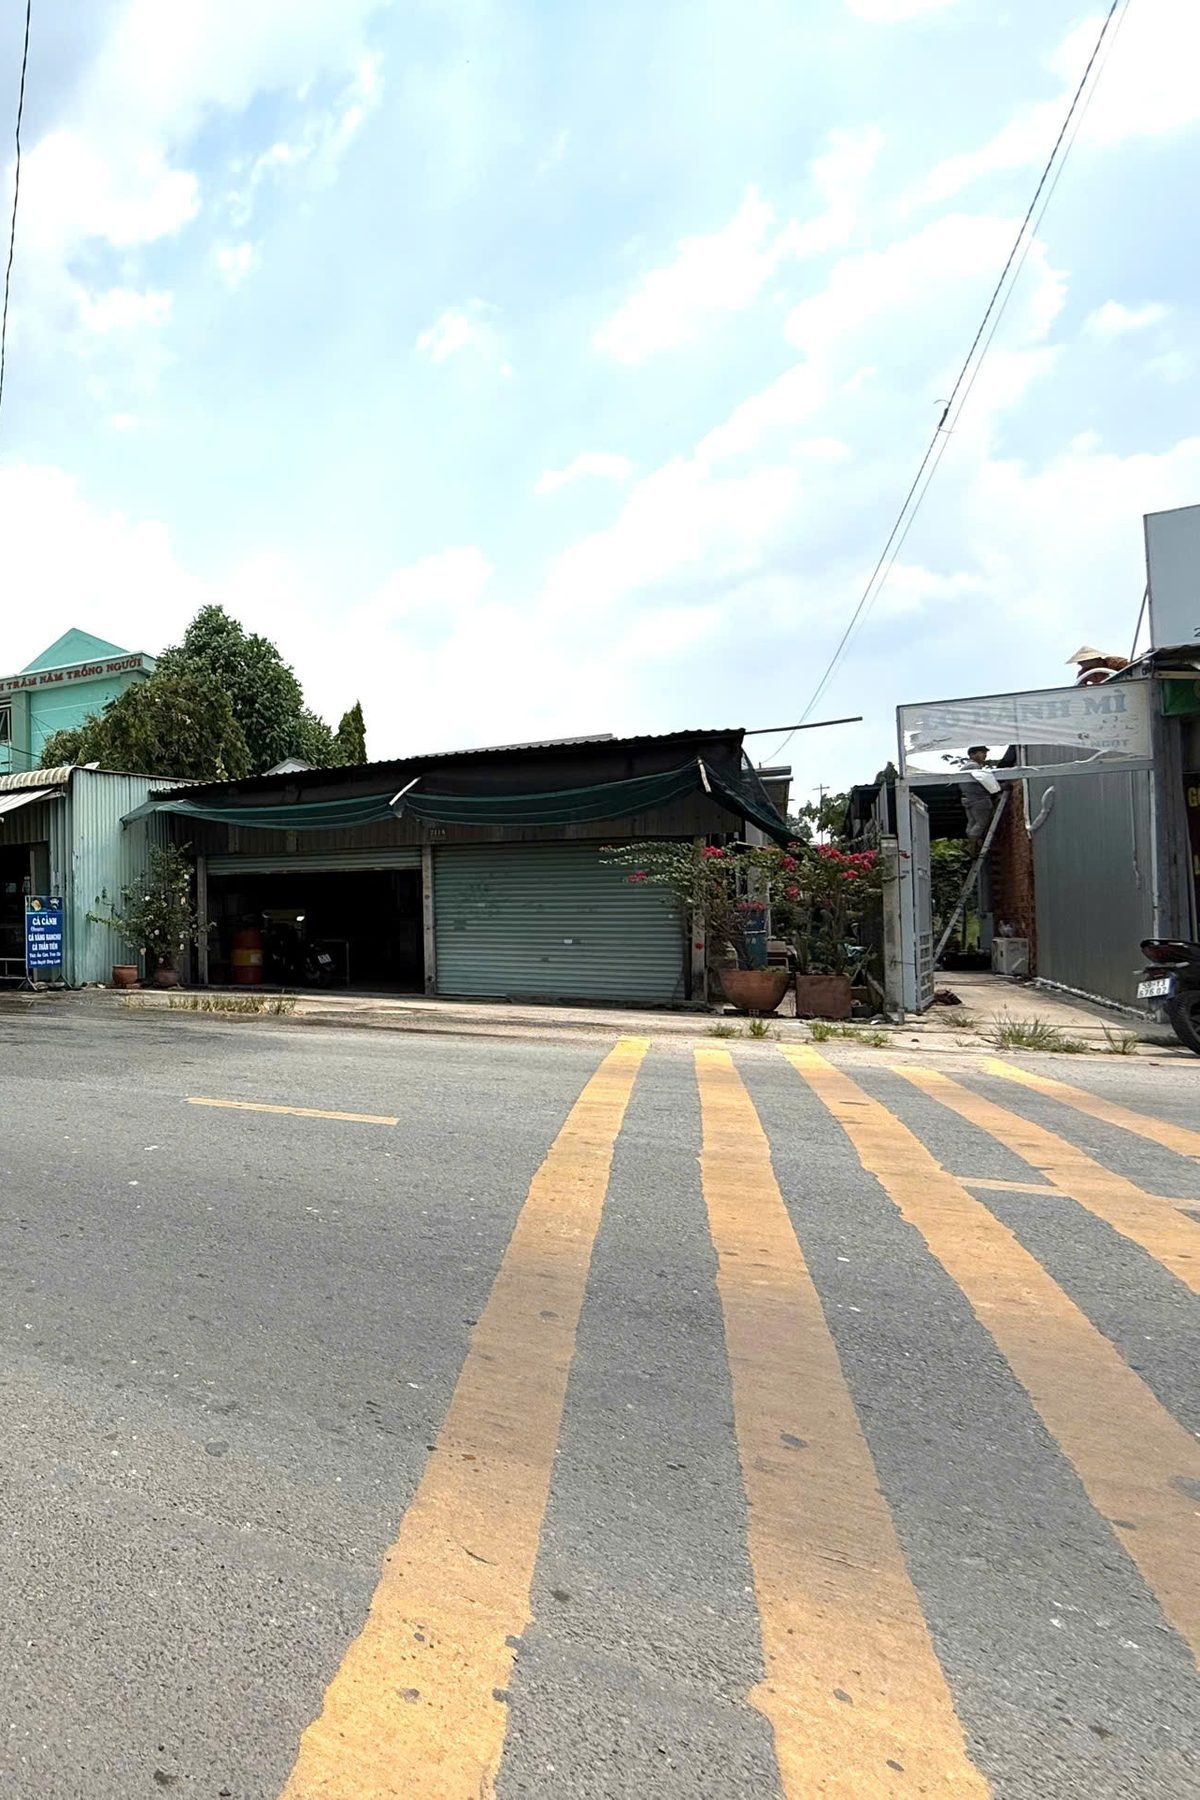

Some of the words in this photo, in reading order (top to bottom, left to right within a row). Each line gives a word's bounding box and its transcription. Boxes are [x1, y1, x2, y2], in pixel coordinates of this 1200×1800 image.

[66, 663, 103, 678] TRỒNG
[106, 657, 141, 673] NGƯỜI
[1082, 688, 1128, 717] MÌ
